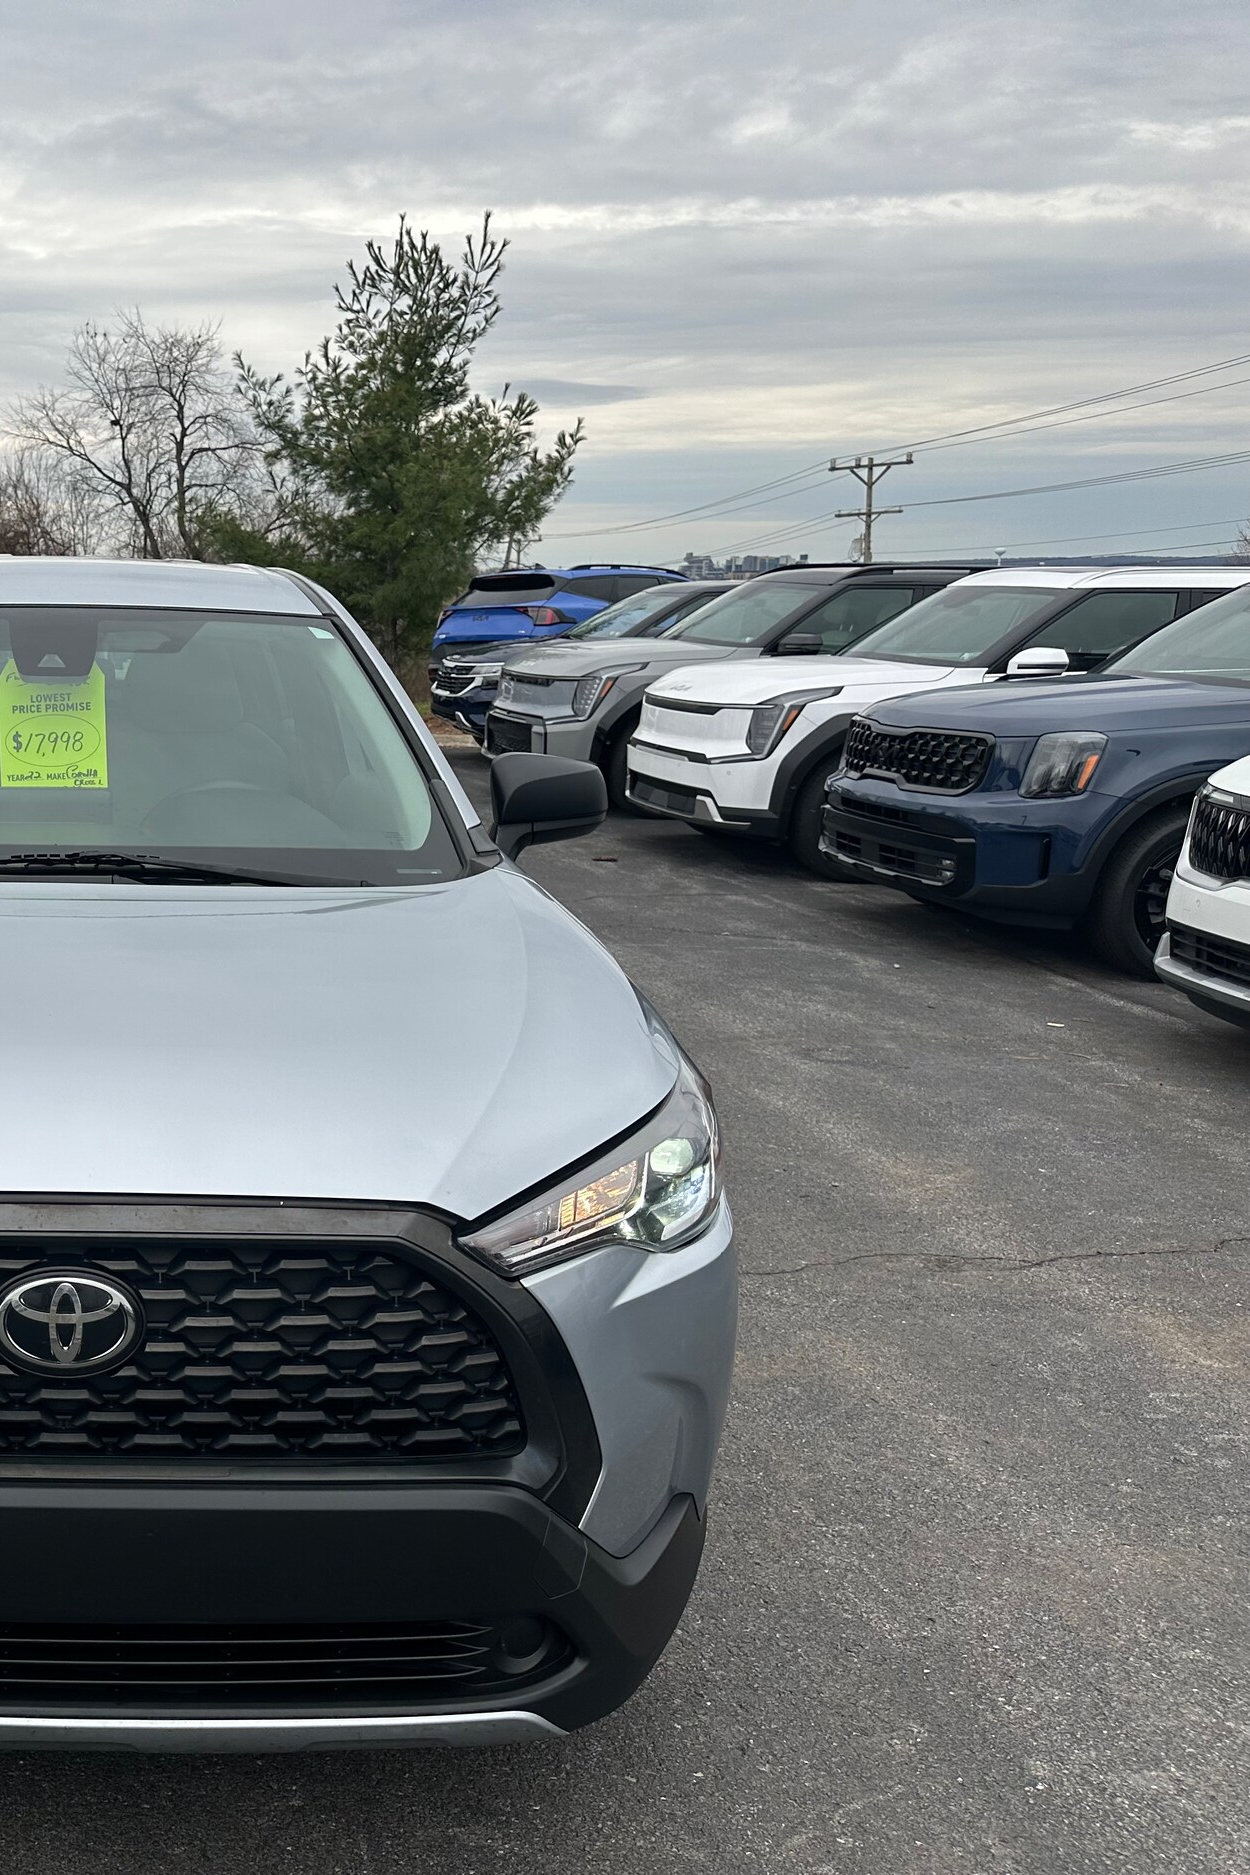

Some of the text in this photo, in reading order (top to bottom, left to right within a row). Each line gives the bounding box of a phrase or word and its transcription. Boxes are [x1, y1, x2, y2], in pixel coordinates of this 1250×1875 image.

[30, 693, 72, 703] LOWEST
[12, 702, 92, 714] PRICE PROMISE
[12, 731, 84, 757] $17,998
[7, 774, 25, 782] YEAR
[46, 773, 66, 781] MAKE
